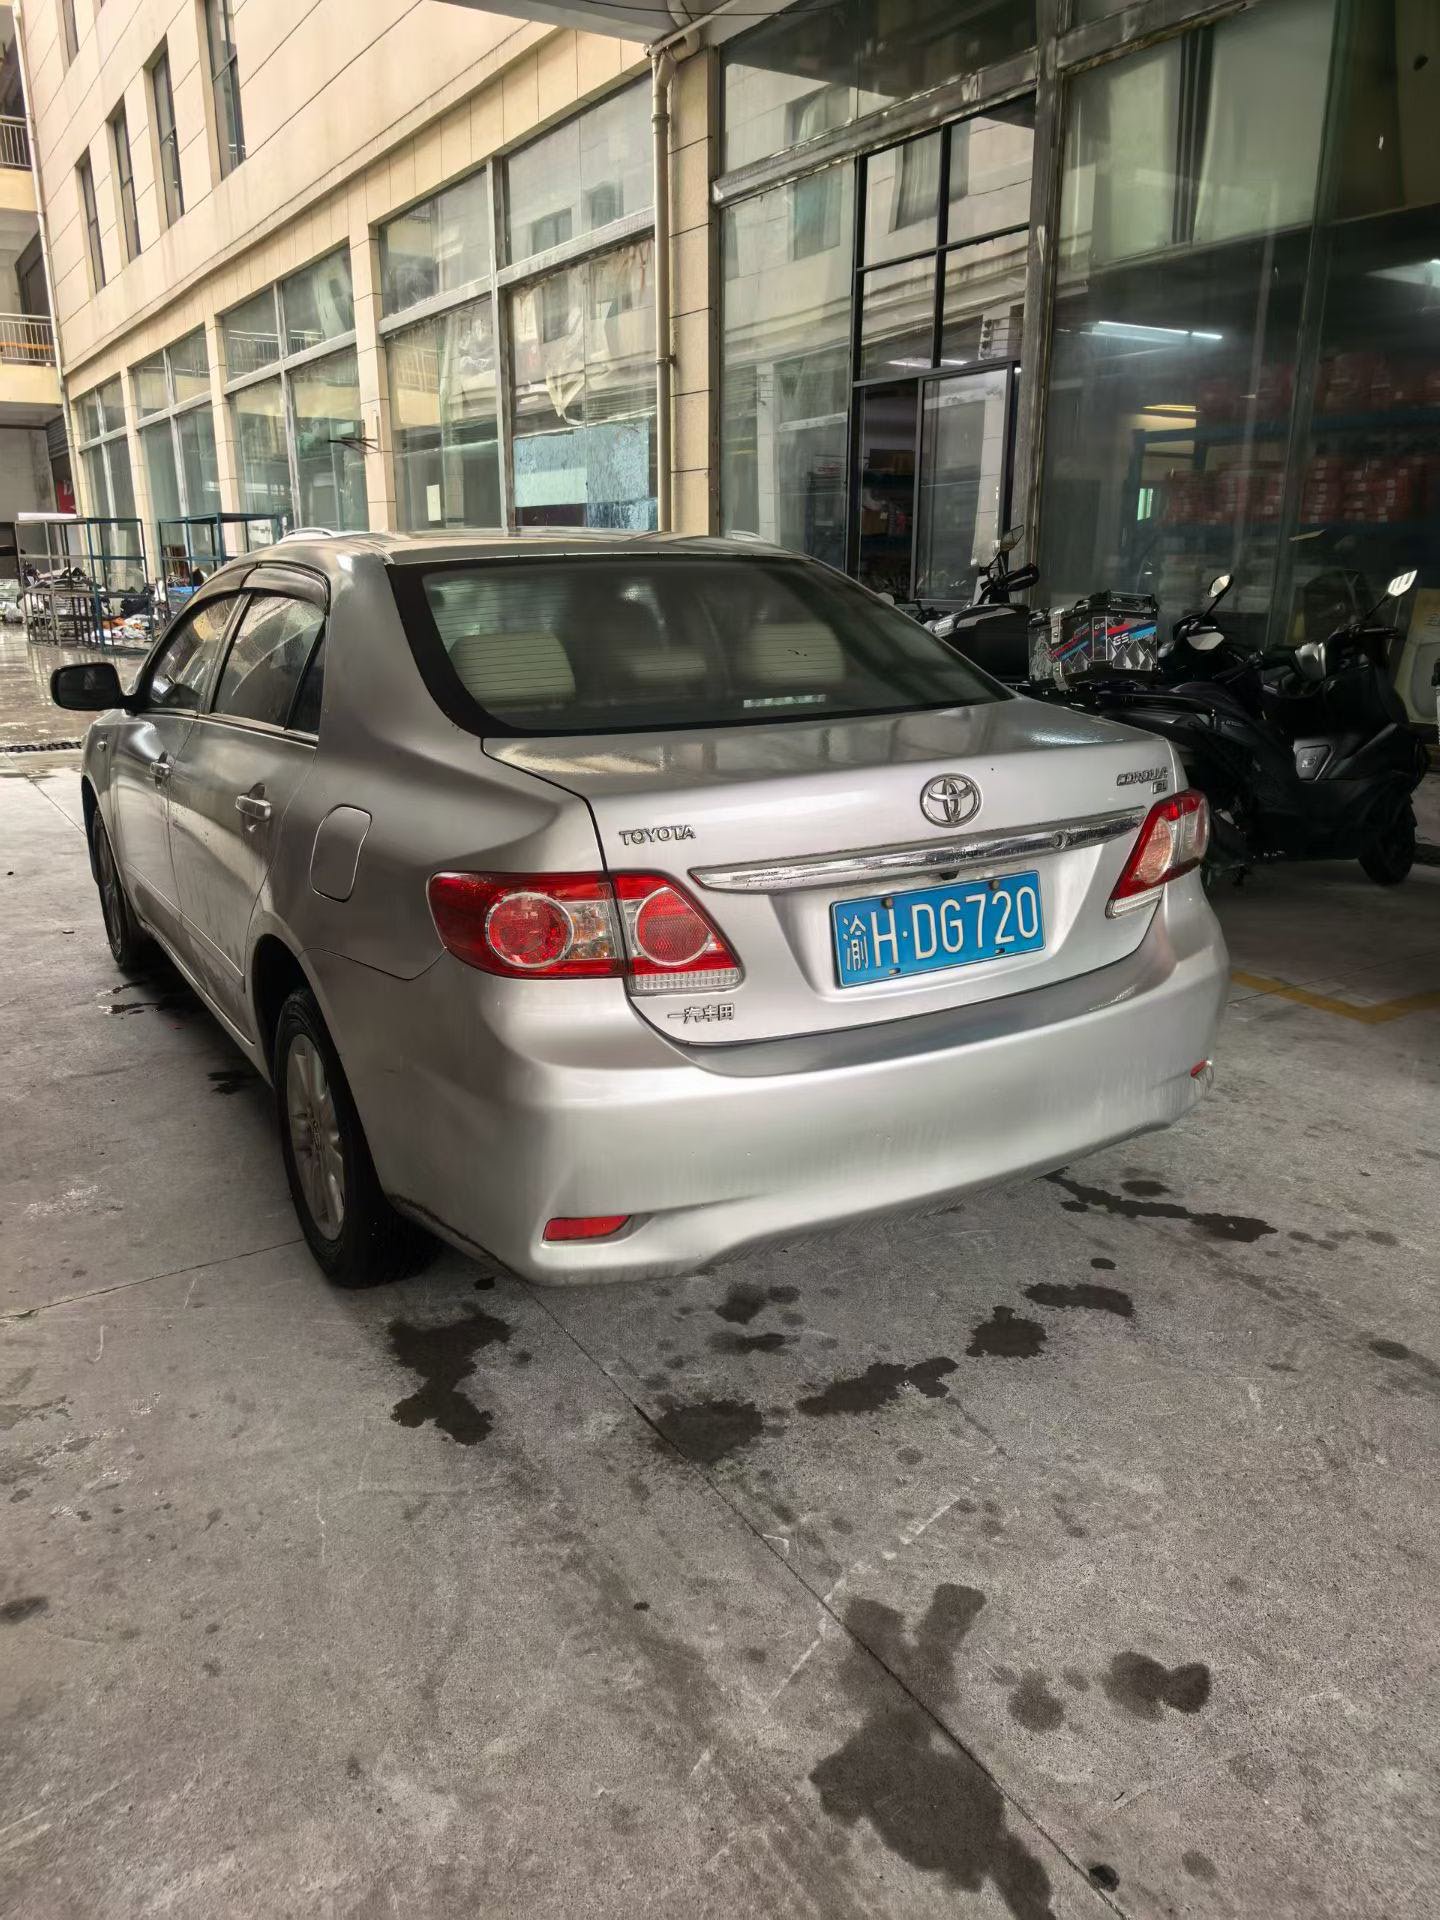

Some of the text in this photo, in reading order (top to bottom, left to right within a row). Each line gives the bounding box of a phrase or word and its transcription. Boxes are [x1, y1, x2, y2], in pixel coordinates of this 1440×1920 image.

[1113, 632, 1130, 646] GS
[618, 825, 697, 846] TOYOTA
[667, 1003, 734, 1024] 一汽丰田
